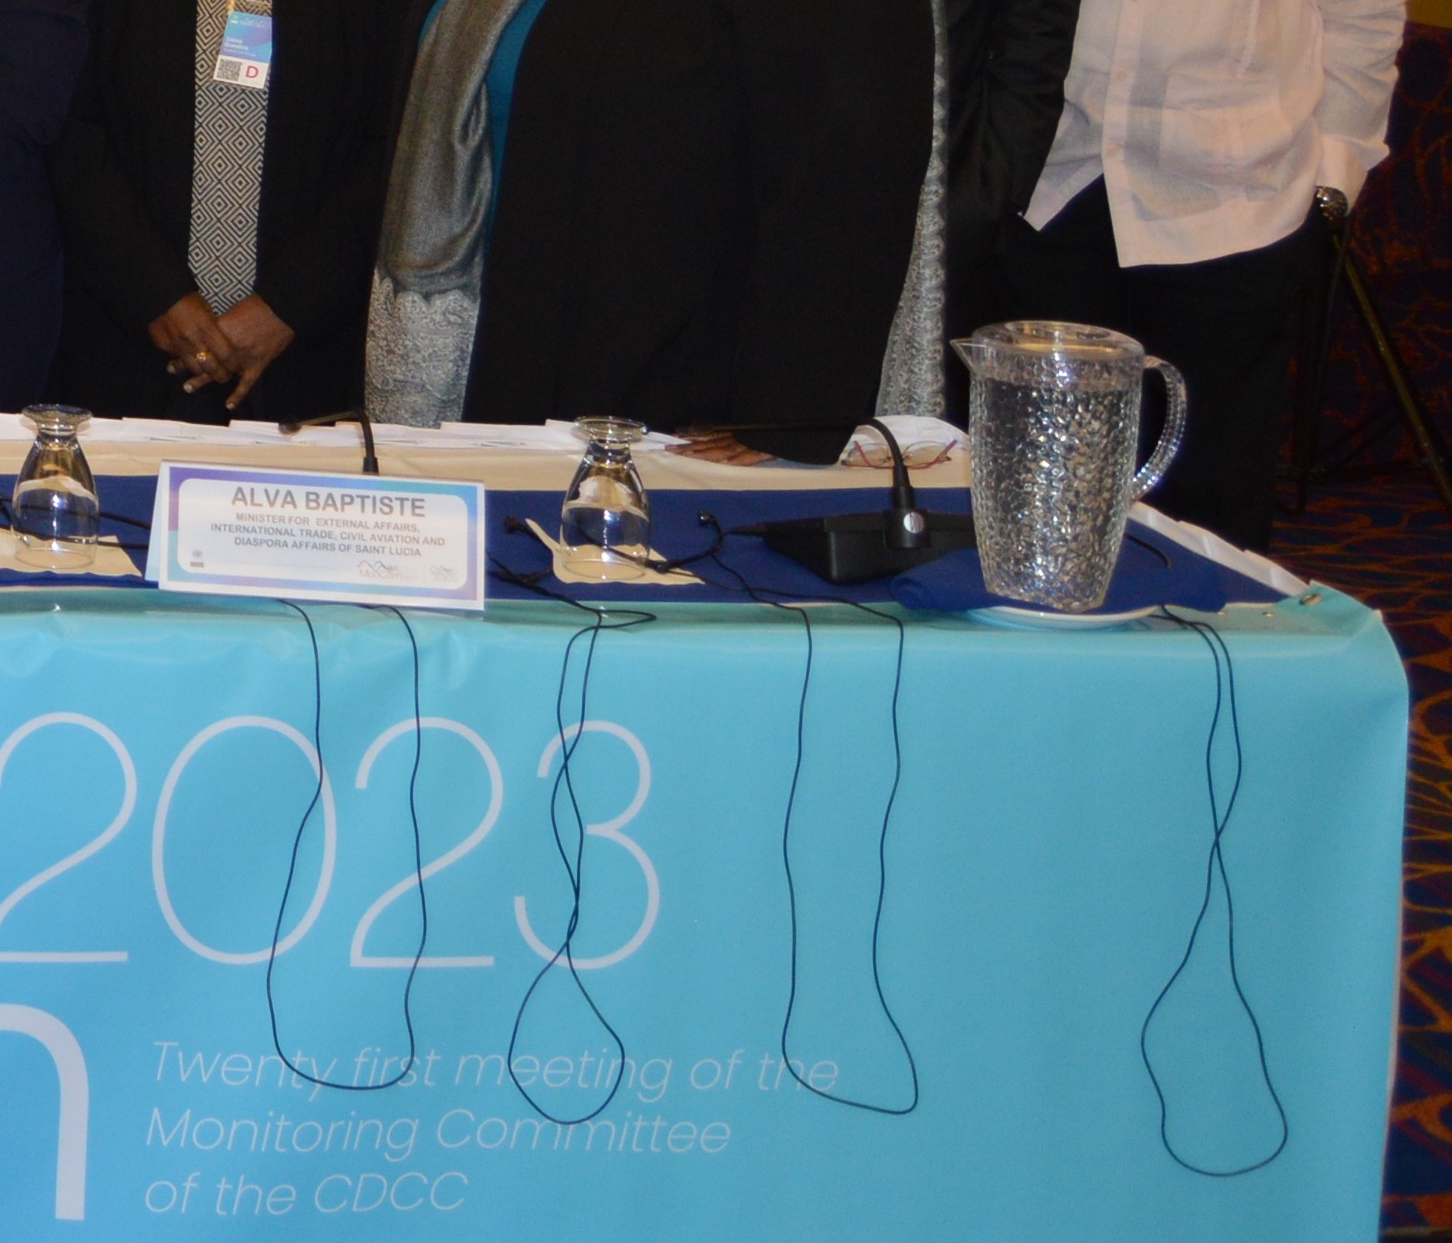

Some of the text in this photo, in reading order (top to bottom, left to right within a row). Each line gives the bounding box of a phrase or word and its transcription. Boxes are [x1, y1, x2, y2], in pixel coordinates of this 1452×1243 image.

[245, 65, 259, 79] D
[231, 486, 426, 517] ALVA BAPTISTE
[210, 523, 445, 547] INTERNATIONAL TRADE, CIVIL AVIATION AND
[236, 513, 421, 533] MINISTER FOR EXTERNAL AFFAIRS,
[234, 536, 422, 558] DIASPORA AFFAIRS OF SAINT LUCIA
[152, 1041, 841, 1102] Twenty first meeting of the
[146, 1108, 732, 1163] Monitoring Committee
[145, 1172, 470, 1216] of the CDCC
